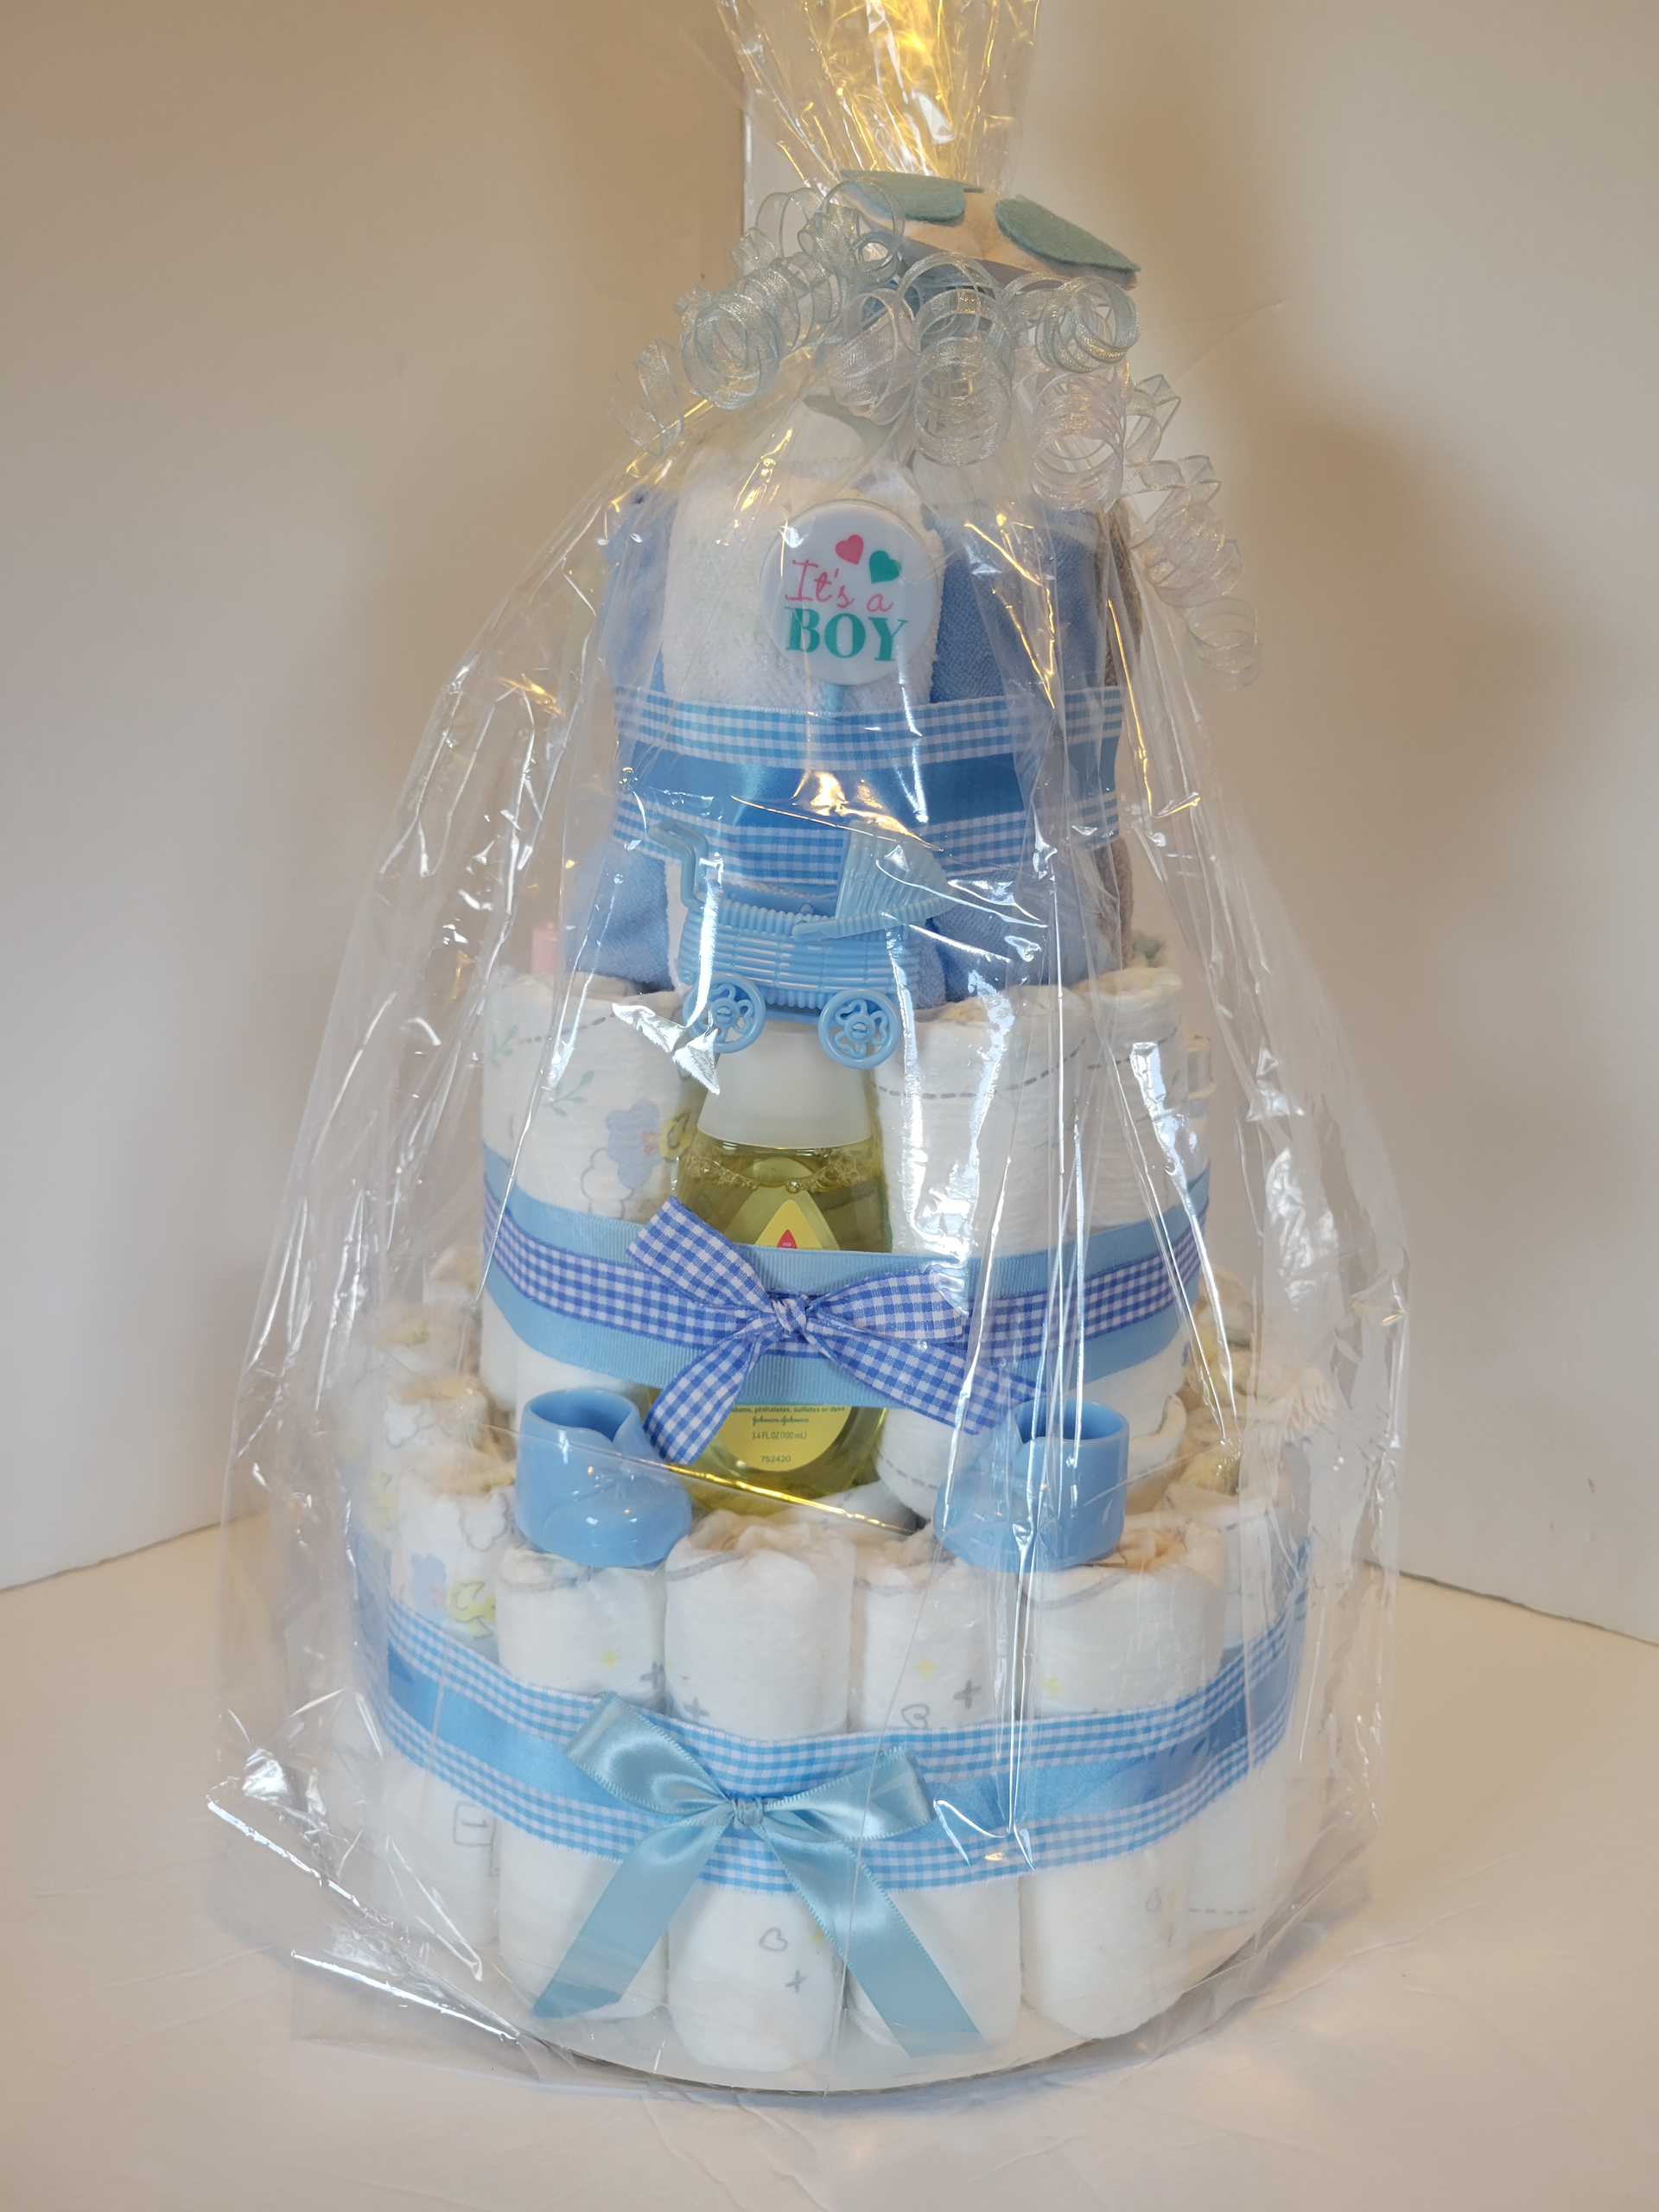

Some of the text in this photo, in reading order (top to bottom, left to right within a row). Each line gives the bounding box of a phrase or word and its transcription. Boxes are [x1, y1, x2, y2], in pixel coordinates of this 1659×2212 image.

[785, 559, 894, 613] It's a
[785, 606, 908, 662] BOY
[752, 1431, 761, 1440] 3.4
[761, 1431, 770, 1440] FL
[771, 1431, 779, 1440] OZ
[780, 1431, 794, 1440] (100
